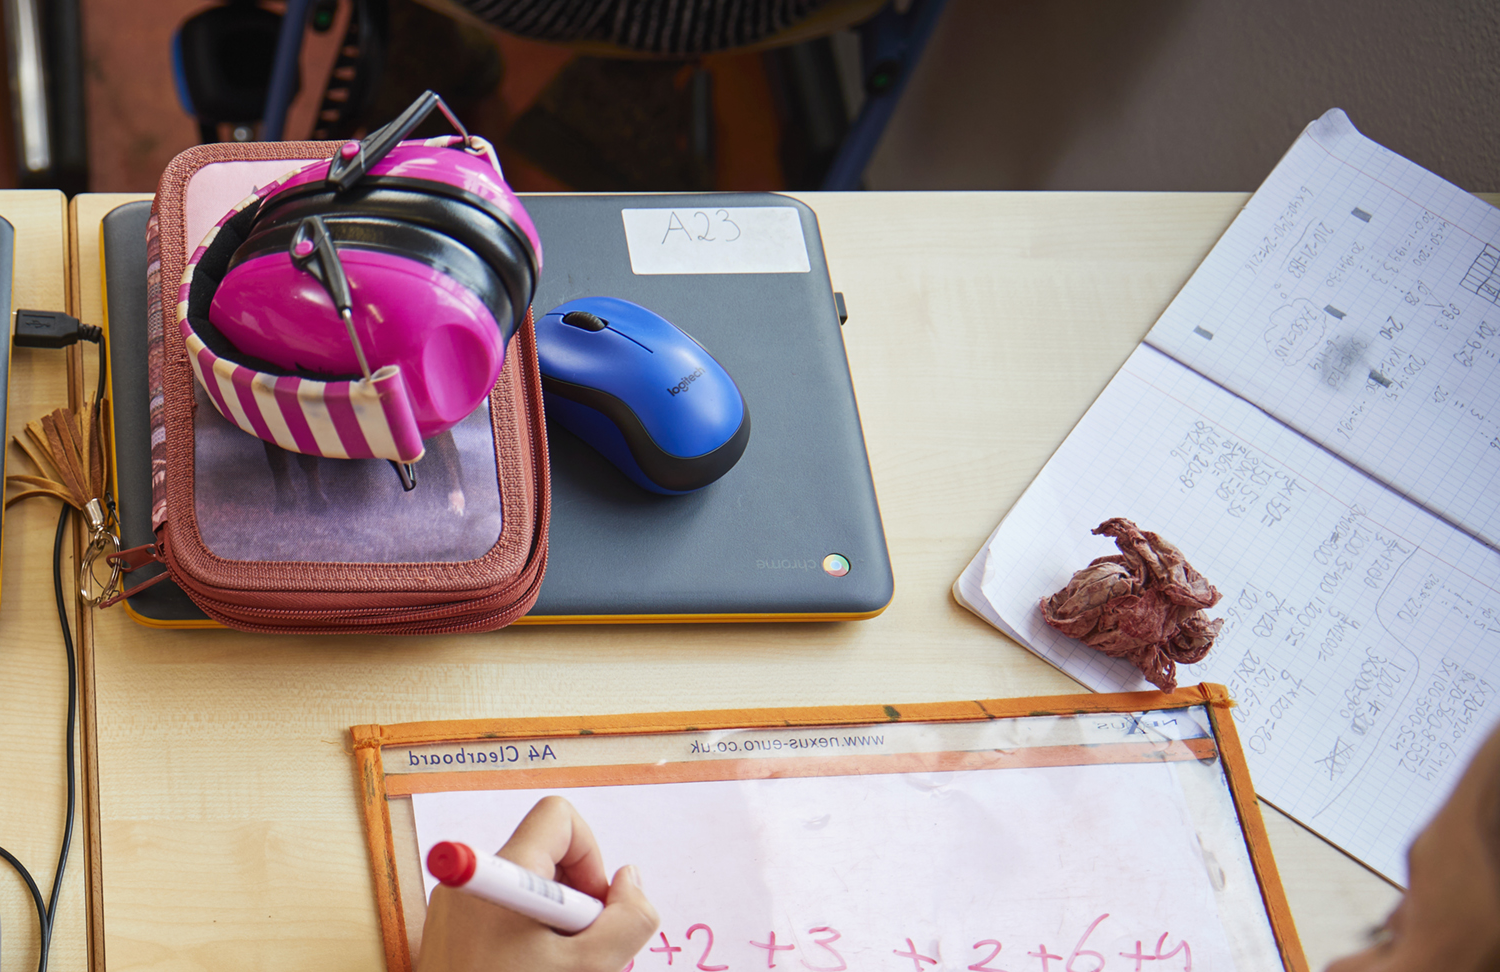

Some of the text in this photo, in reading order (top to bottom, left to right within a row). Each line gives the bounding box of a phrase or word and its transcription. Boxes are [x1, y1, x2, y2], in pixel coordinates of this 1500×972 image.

[661, 209, 741, 244] A23
[667, 366, 706, 397] logitech
[756, 559, 816, 571] chrome
